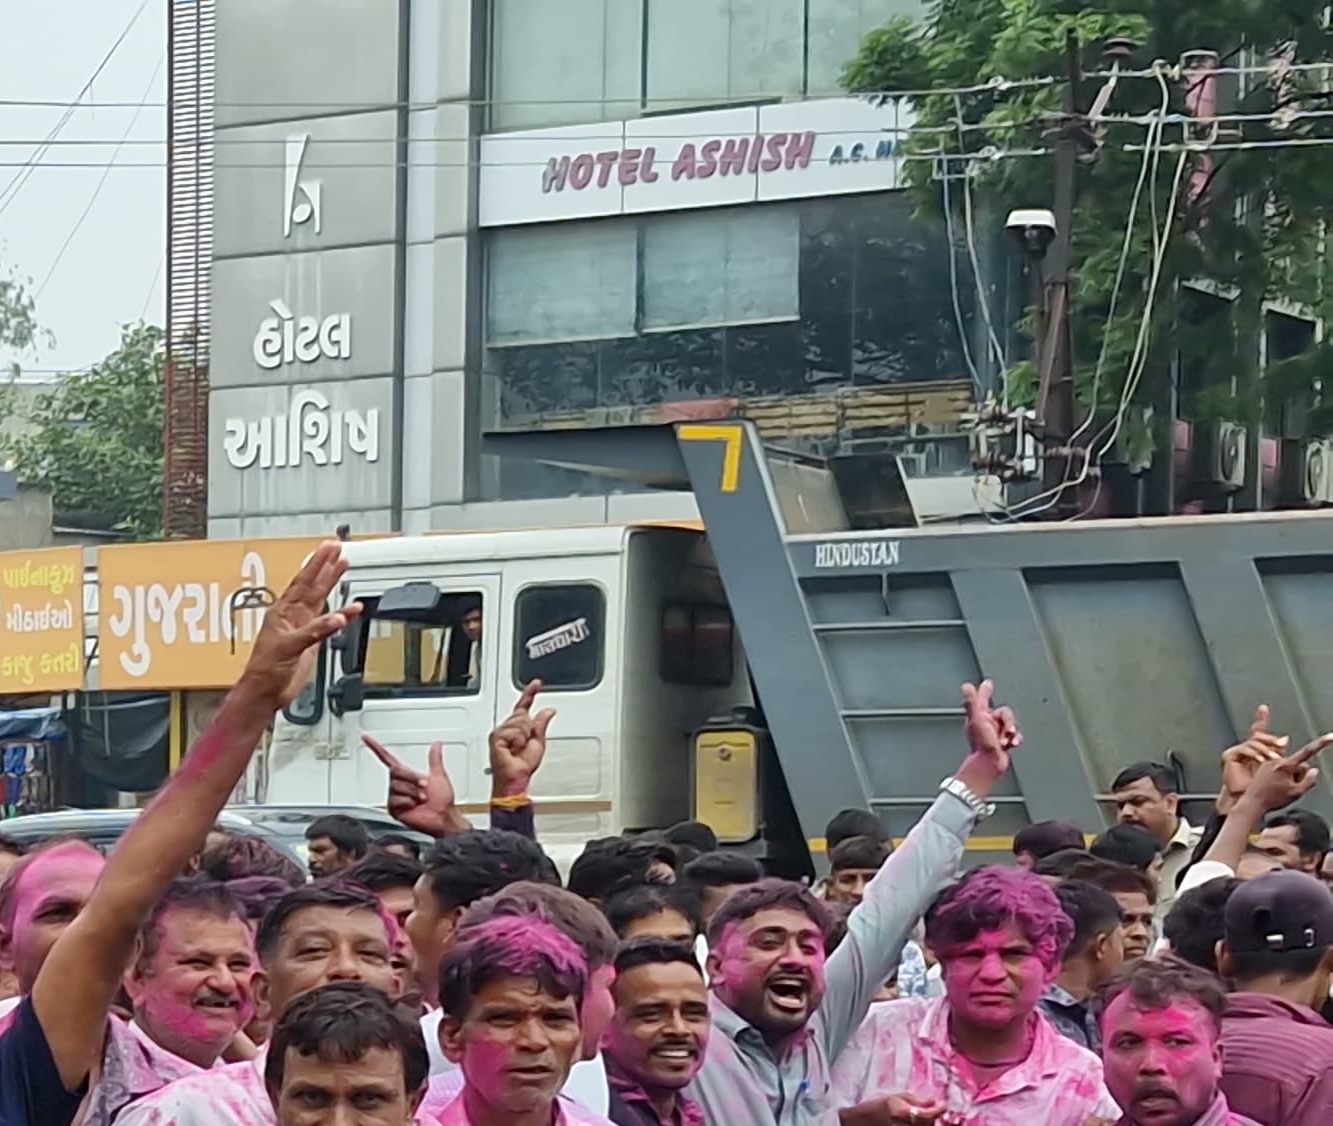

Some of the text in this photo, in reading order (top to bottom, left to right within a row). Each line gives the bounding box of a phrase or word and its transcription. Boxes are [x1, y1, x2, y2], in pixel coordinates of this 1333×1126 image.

[542, 147, 659, 194] HOTEL
[671, 130, 816, 181] ASHISH
[252, 299, 352, 369] હોટલ
[223, 388, 380, 469] આશિષ
[814, 540, 901, 568] HINDUSTAN
[5, 599, 73, 633] મીઠાઈઓ
[108, 551, 267, 677] ગુજરાતી
[1, 642, 79, 685] કાજુ કતરી
